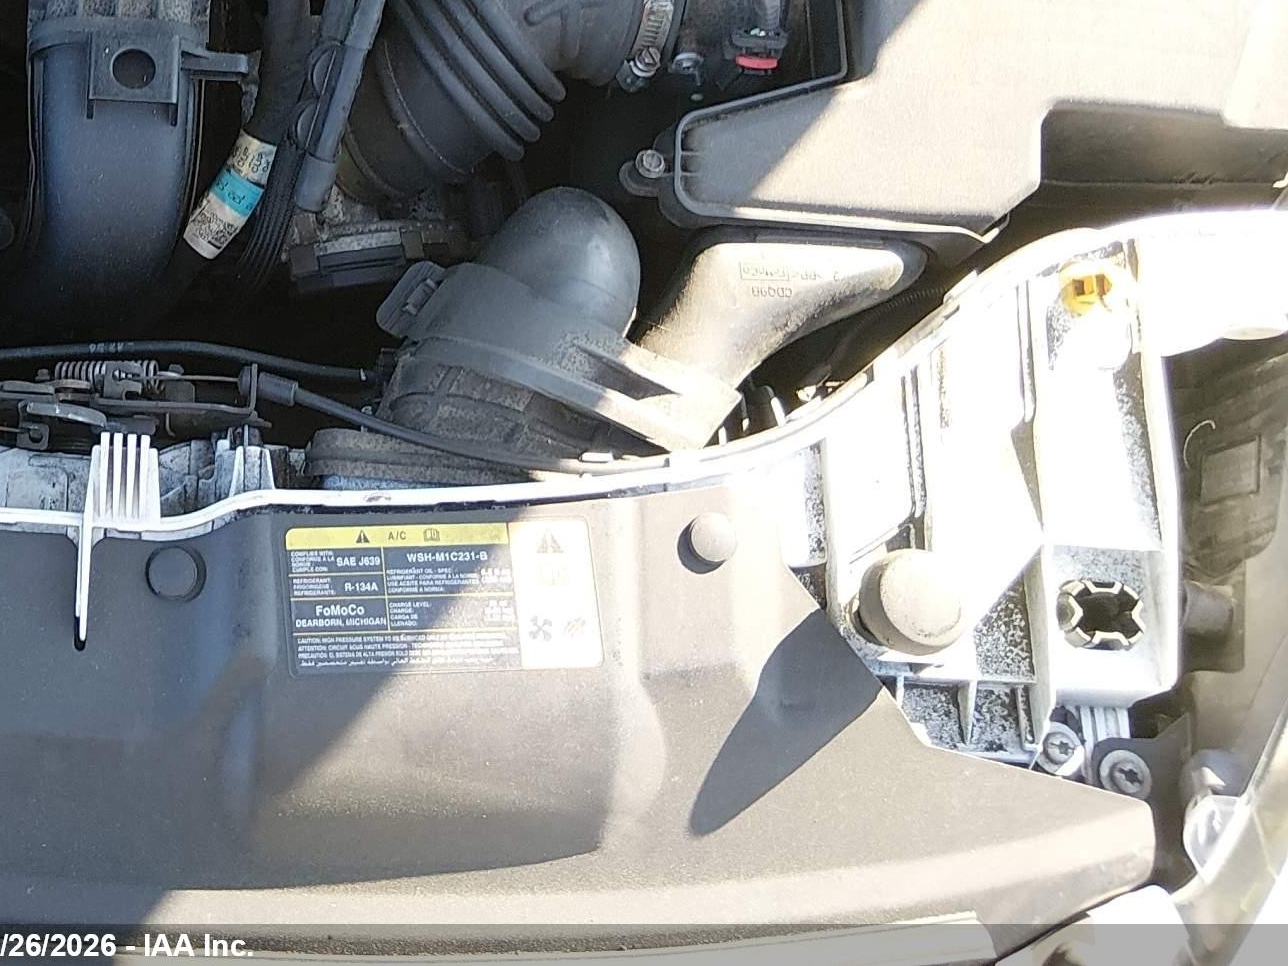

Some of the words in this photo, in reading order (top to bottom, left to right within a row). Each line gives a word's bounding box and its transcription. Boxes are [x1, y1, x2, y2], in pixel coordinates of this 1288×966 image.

[388, 530, 407, 540] A/C
[336, 557, 356, 566] SAE
[359, 556, 381, 566] J639
[407, 551, 488, 562] WSH-M1C231-B
[345, 582, 378, 592] R-134A
[315, 604, 365, 616] FoMoCo
[296, 618, 344, 627] DEARBORN,
[346, 617, 387, 626] MICHIGAN
